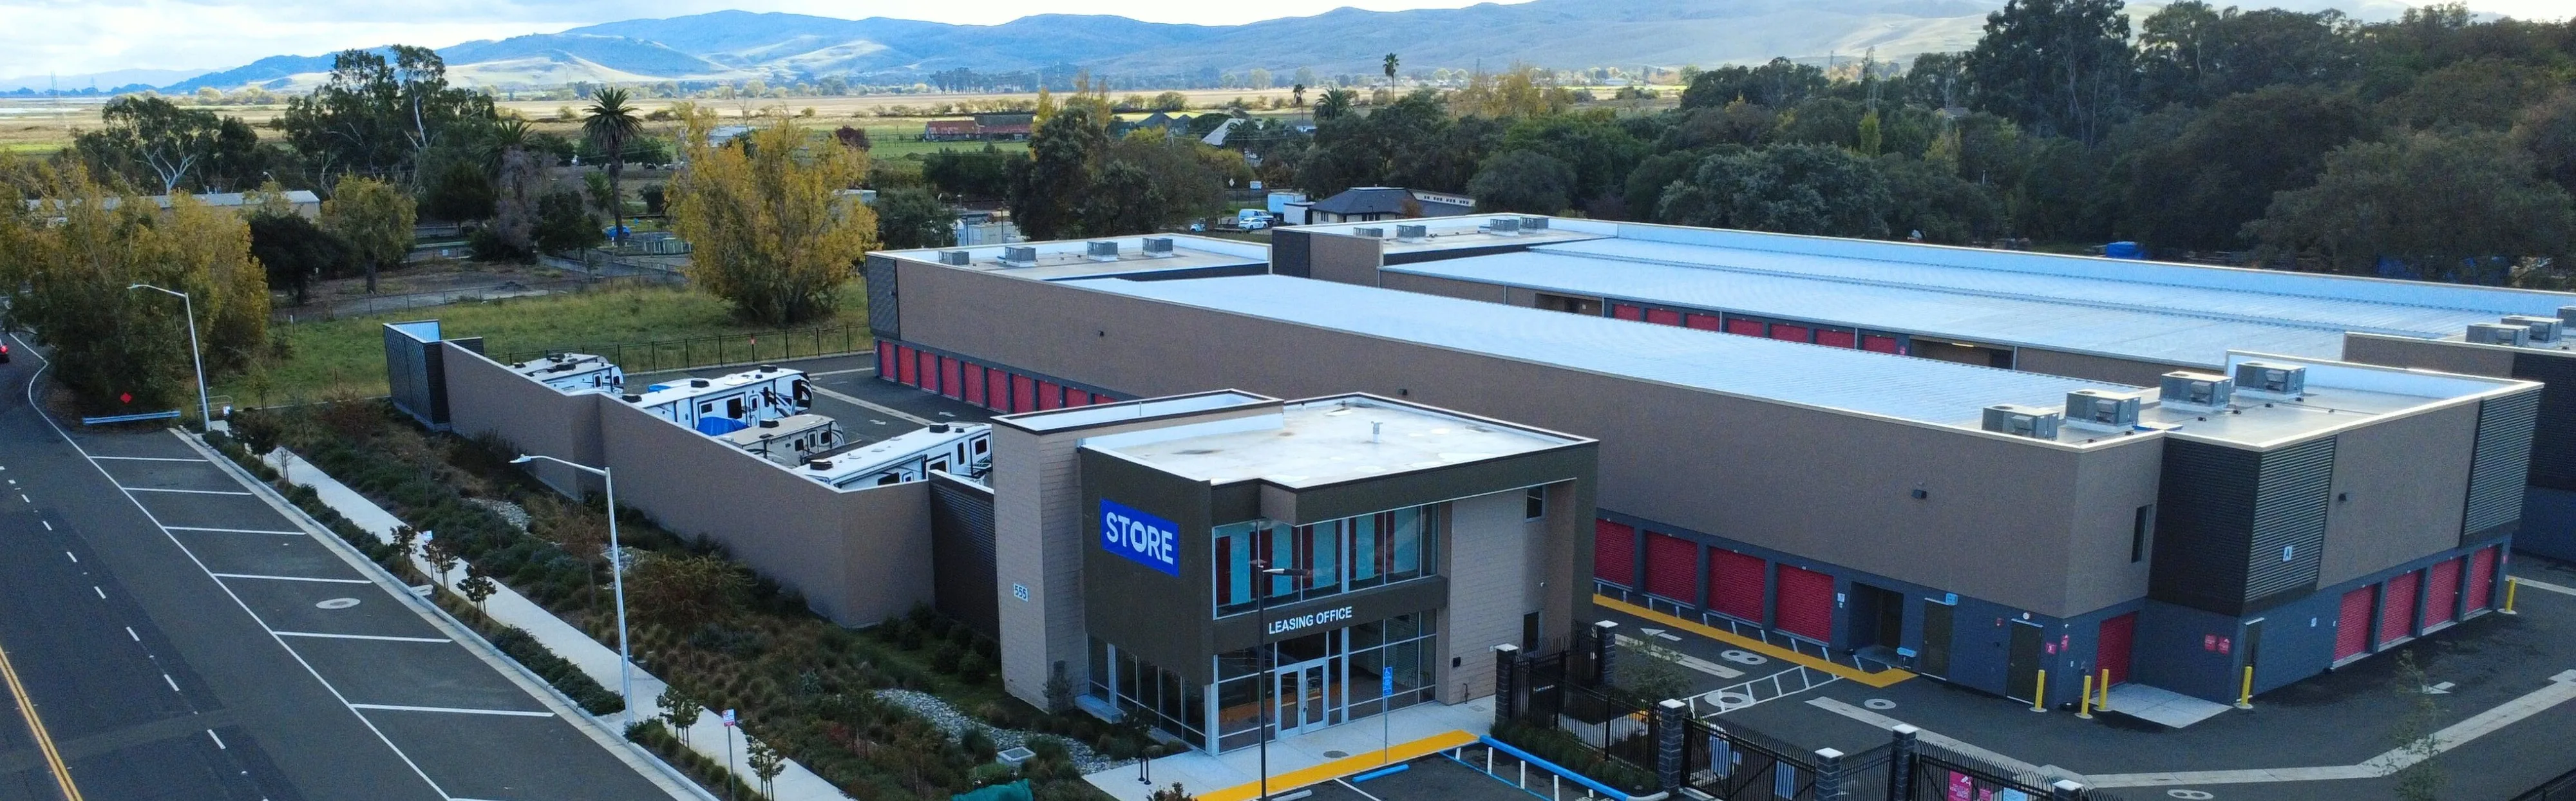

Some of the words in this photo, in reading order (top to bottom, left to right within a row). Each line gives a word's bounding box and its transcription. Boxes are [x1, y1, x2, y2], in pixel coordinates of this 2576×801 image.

[1106, 512, 1173, 565] STORE
[1014, 585, 1027, 599] 555
[1269, 614, 1314, 635] LEASING
[1316, 606, 1353, 625] OFFICE
